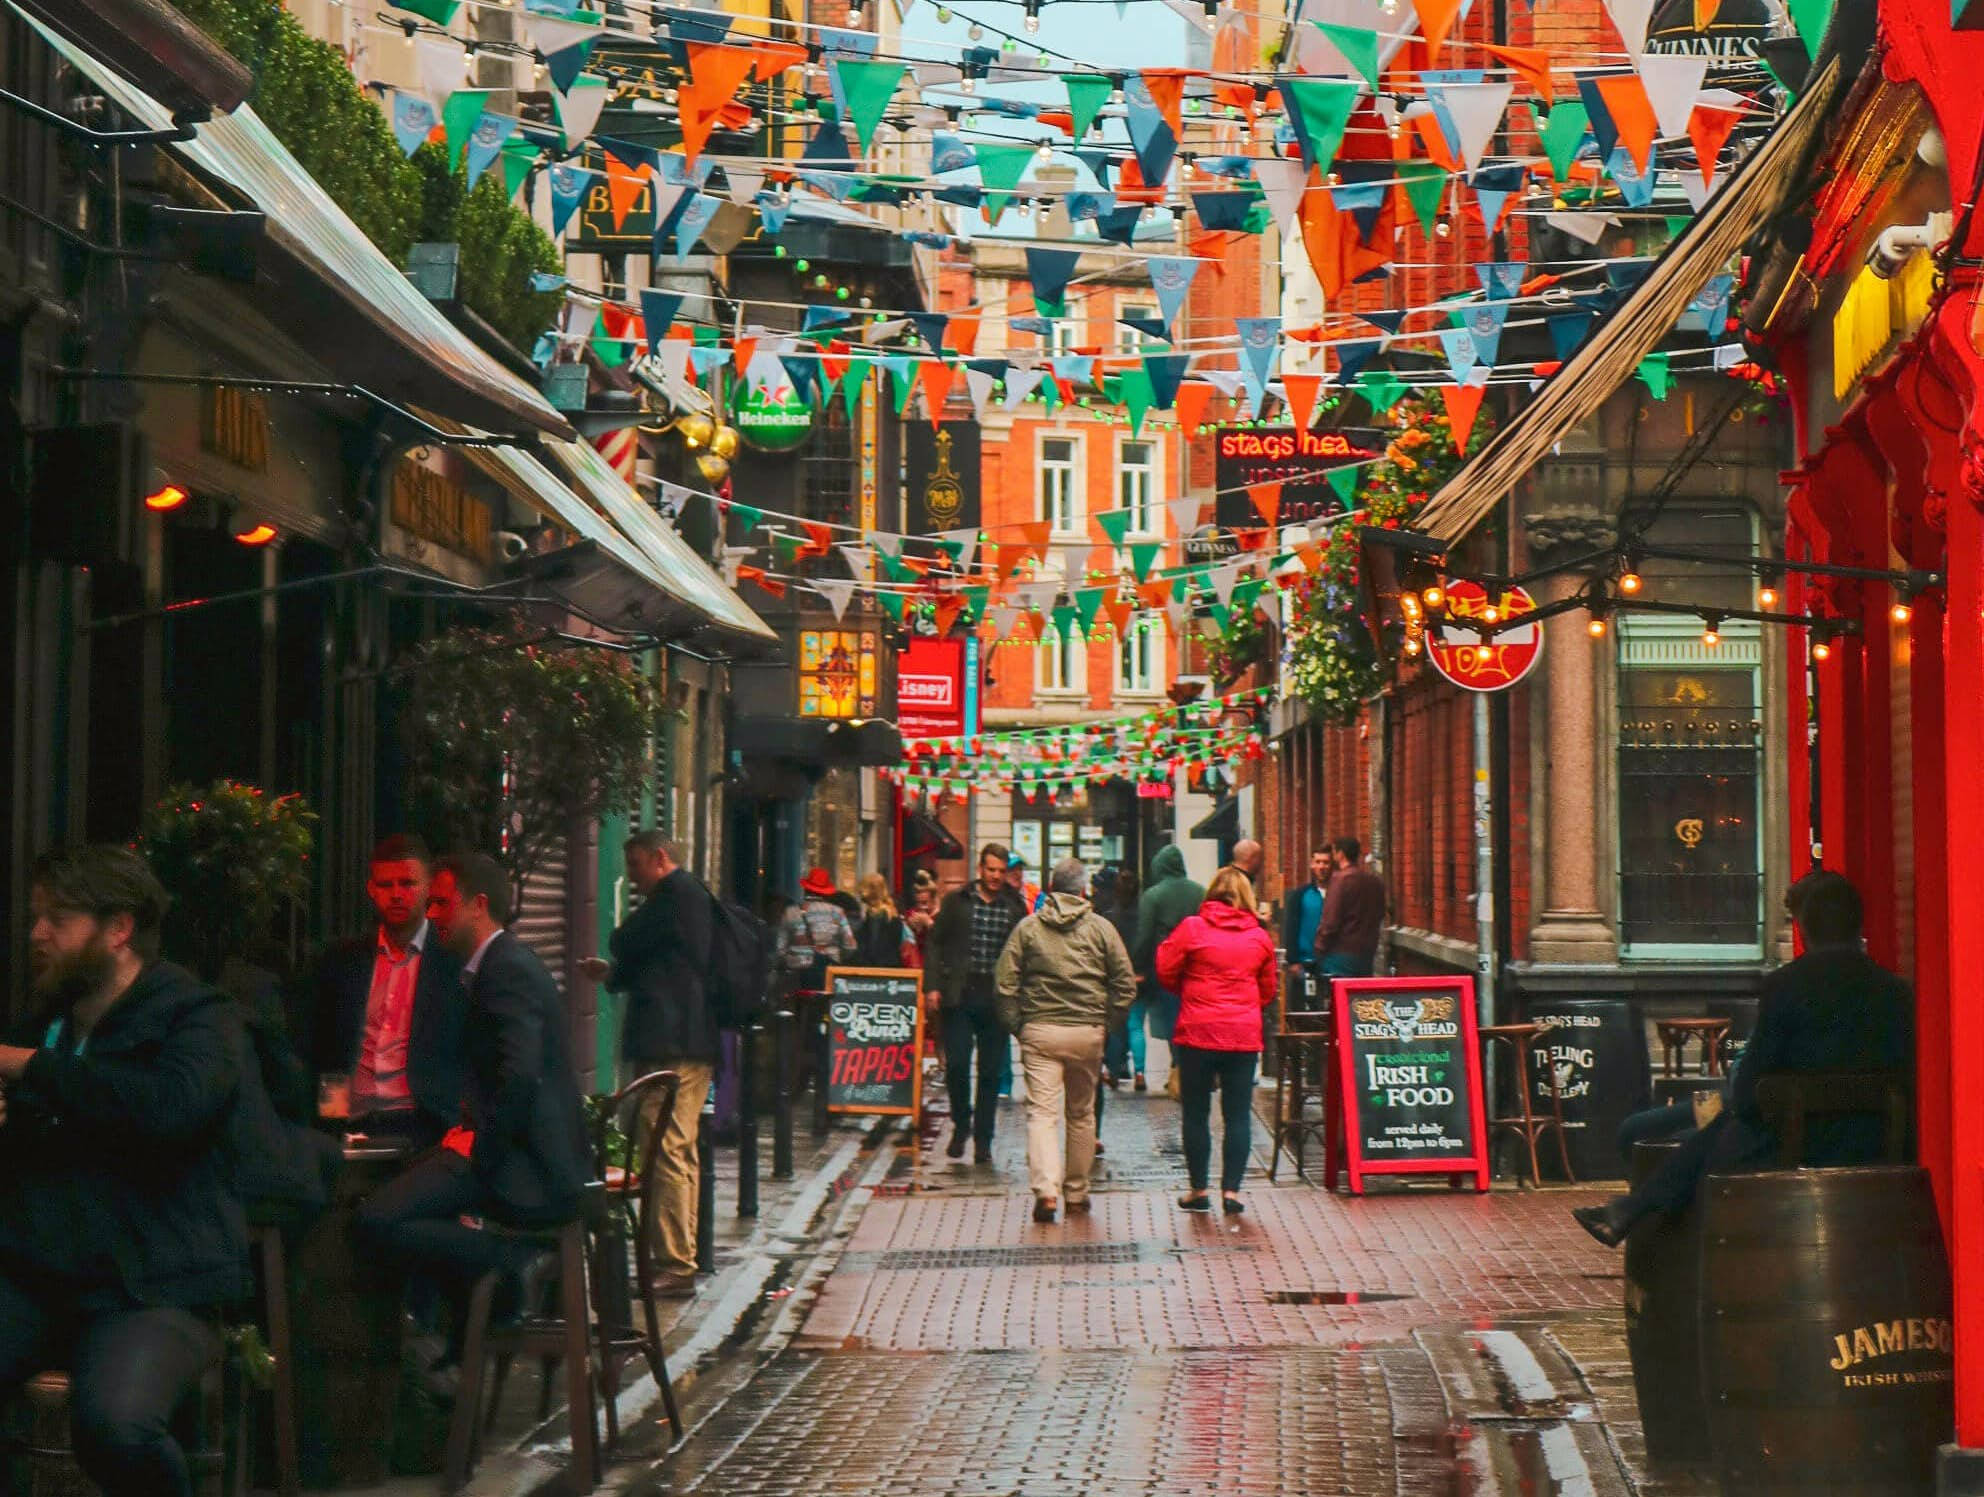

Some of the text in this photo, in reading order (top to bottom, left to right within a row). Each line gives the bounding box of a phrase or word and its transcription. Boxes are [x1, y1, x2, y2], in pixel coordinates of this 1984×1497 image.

[739, 411, 811, 425] Heineken
[1222, 432, 1366, 460] stags hea
[831, 1002, 917, 1025] OPEN
[1418, 1022, 1458, 1035] HEAD
[830, 1042, 915, 1085] TAPAS
[1365, 1053, 1428, 1090] IRISH
[1386, 1087, 1455, 1107] FOOD
[1384, 1122, 1445, 1136] served daily
[1367, 1136, 1464, 1150] from 12pm to 6pm
[1844, 1373, 1898, 1387] IRISH
